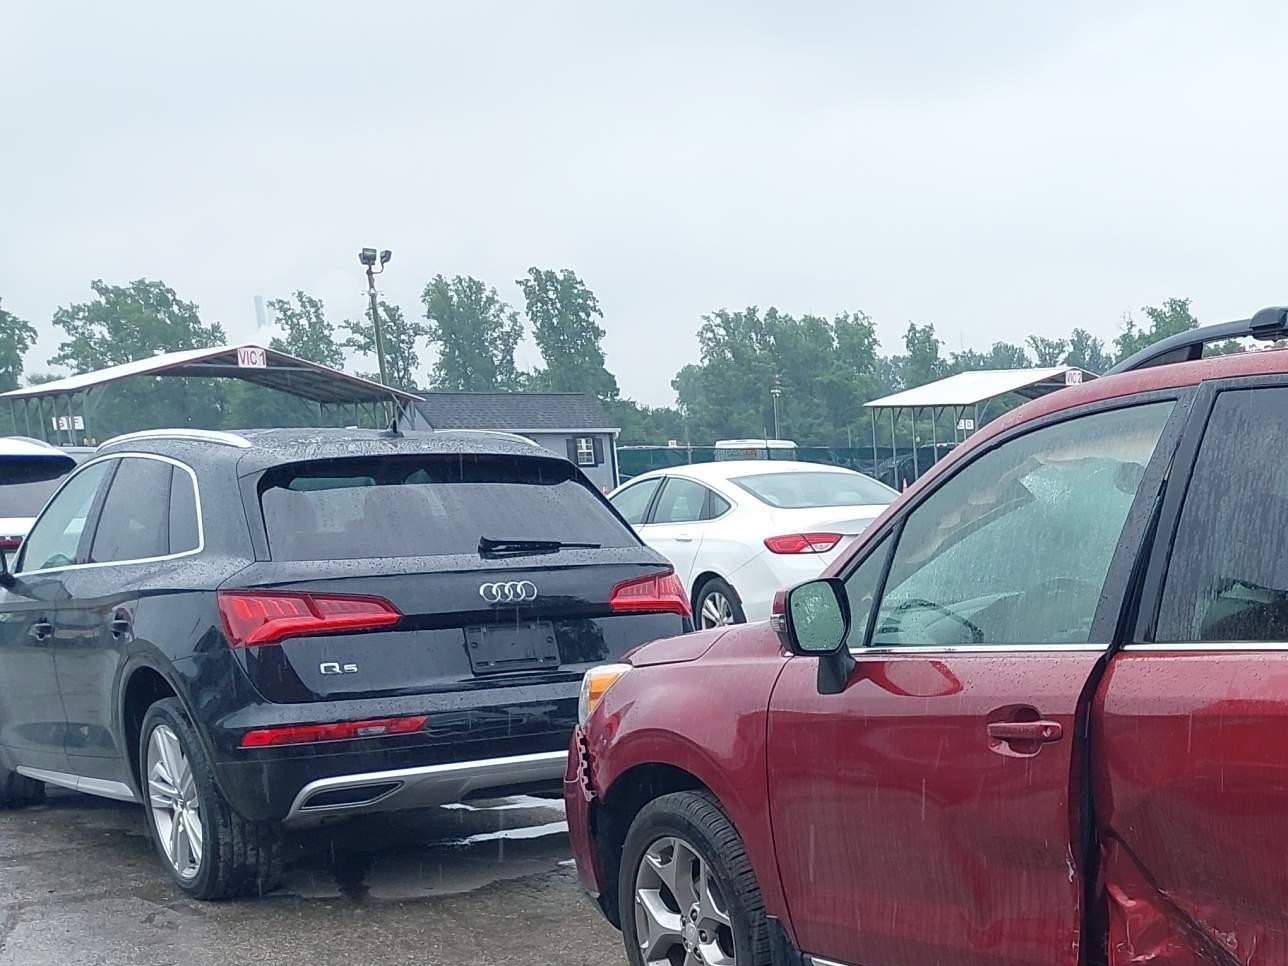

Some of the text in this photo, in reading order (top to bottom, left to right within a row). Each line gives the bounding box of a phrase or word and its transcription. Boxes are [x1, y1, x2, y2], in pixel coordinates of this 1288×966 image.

[239, 350, 266, 366] VIC 1
[320, 662, 358, 675] Q5
